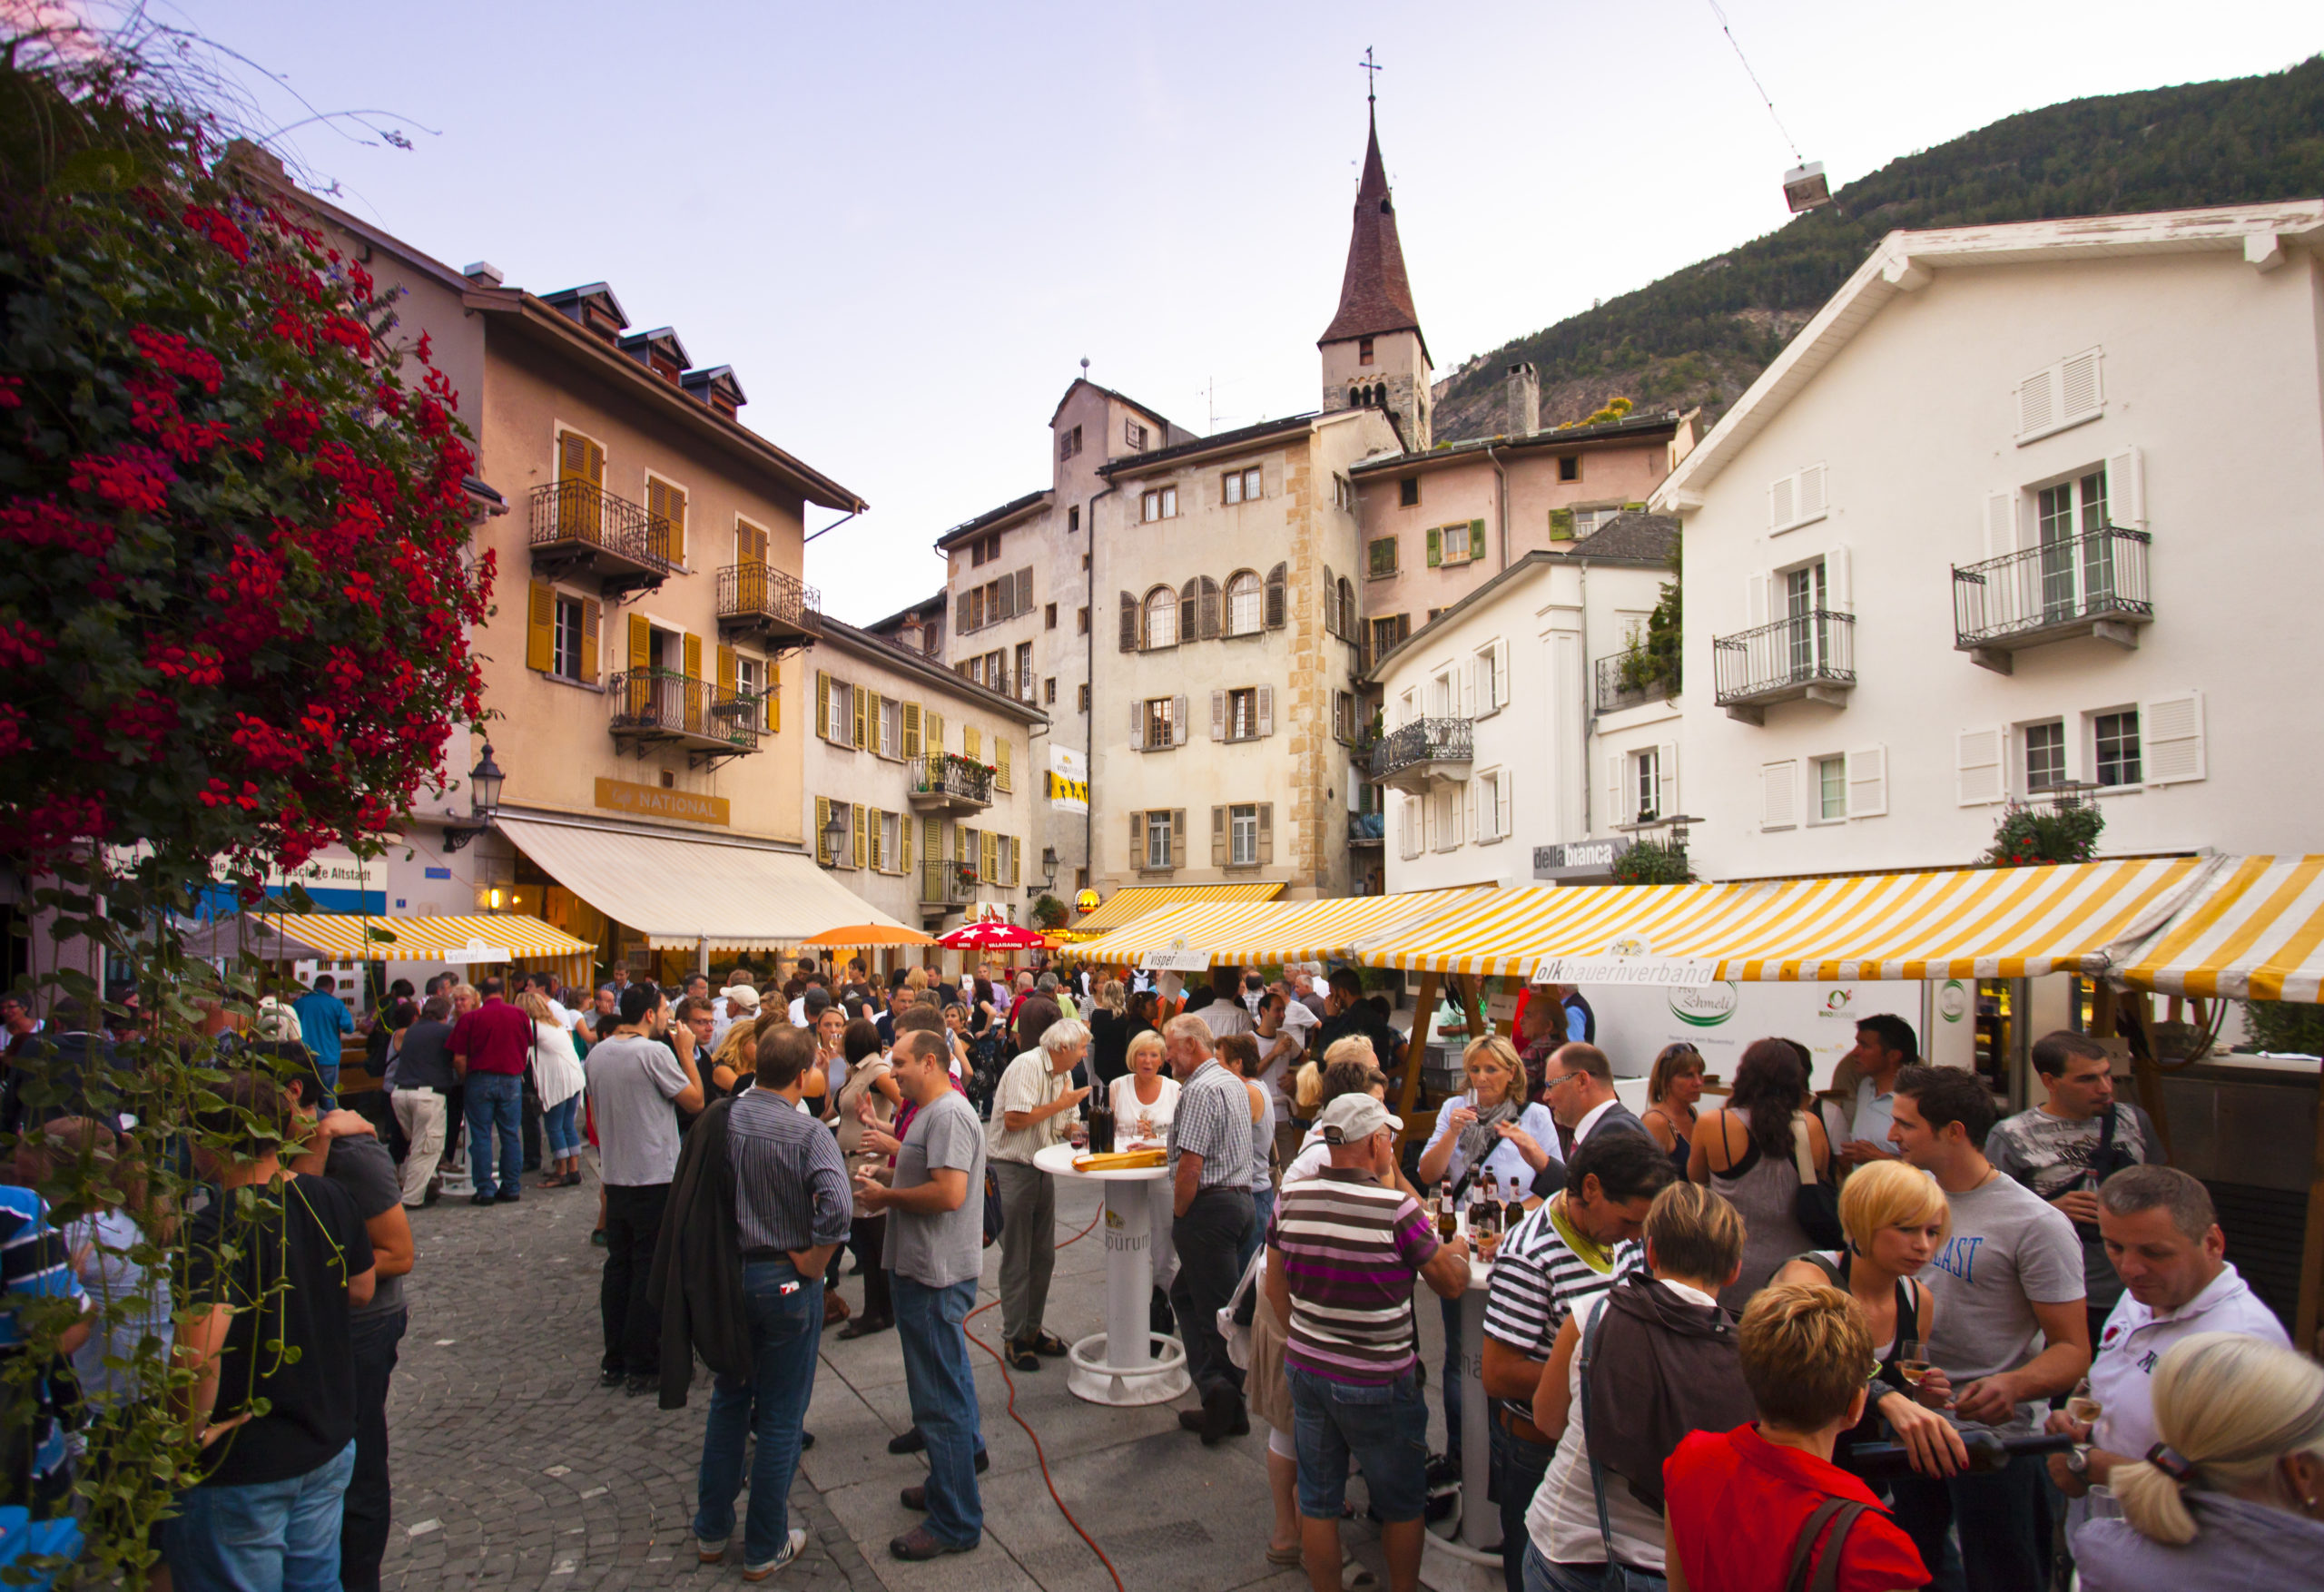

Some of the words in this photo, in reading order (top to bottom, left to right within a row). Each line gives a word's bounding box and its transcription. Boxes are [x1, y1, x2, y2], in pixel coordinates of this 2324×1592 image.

[639, 791, 716, 817] NATIONAL
[1534, 844, 1612, 869] dellabianca
[275, 863, 328, 881] laschge
[331, 867, 371, 881] Altstadt
